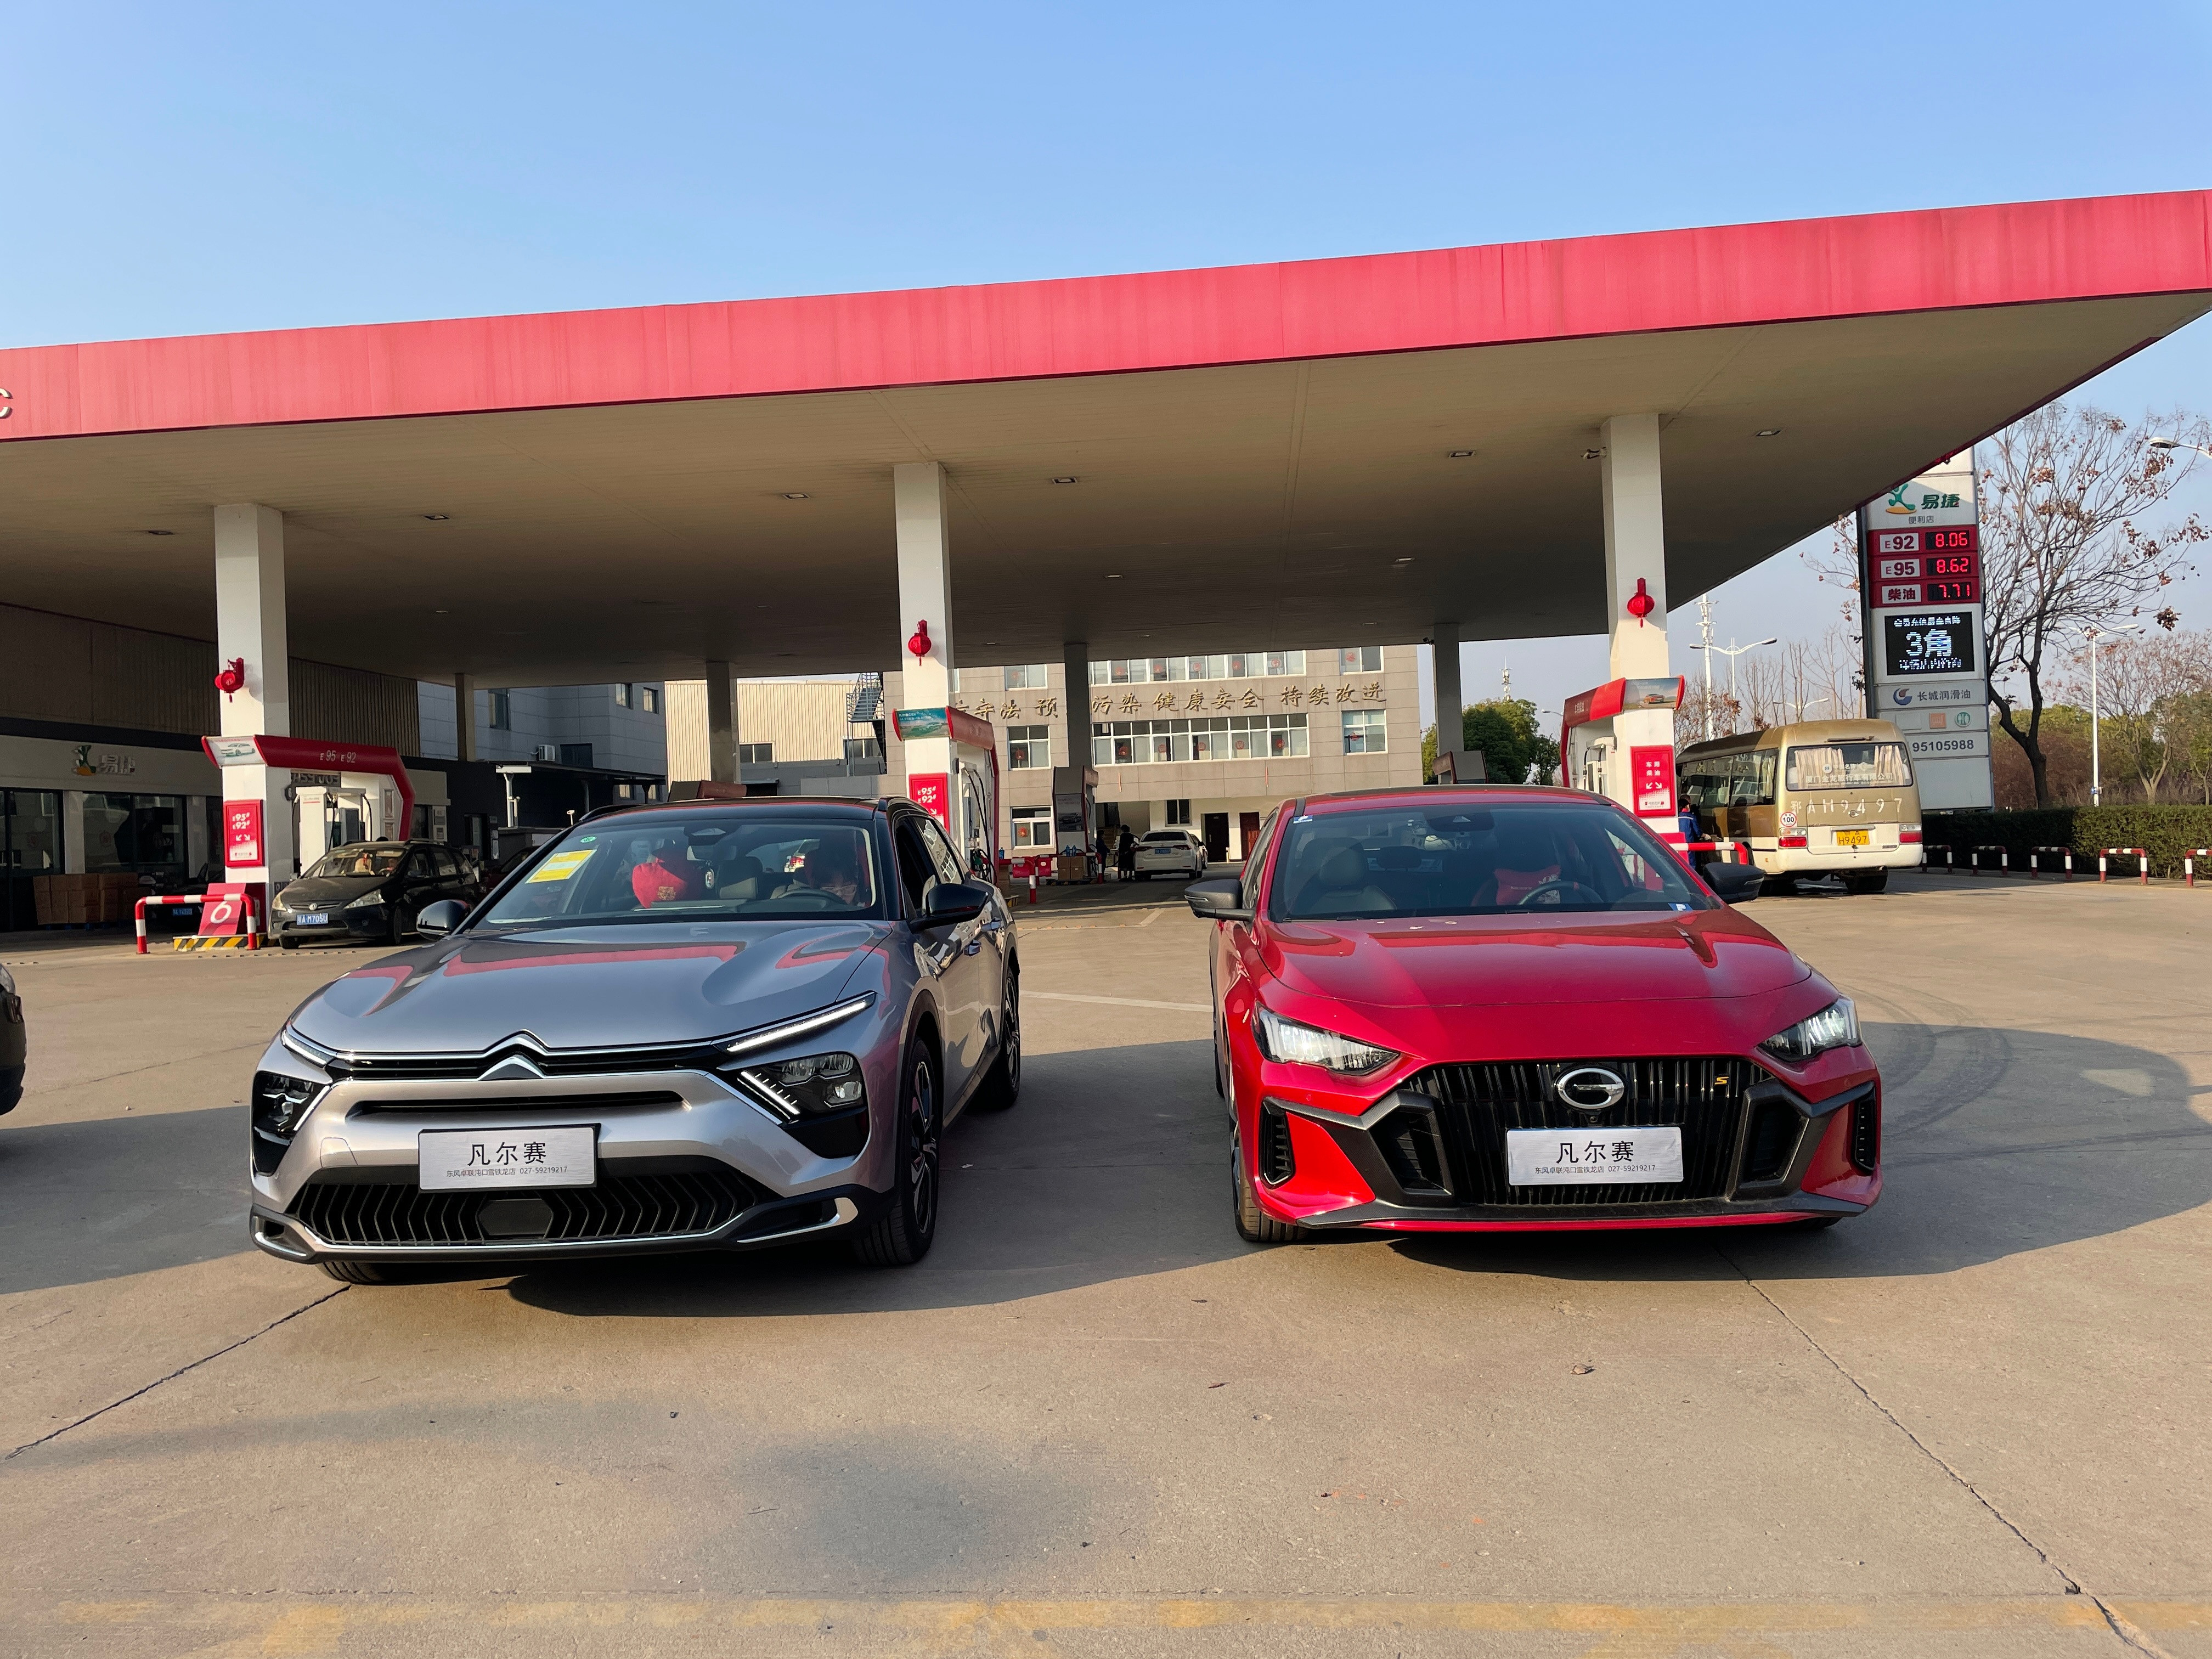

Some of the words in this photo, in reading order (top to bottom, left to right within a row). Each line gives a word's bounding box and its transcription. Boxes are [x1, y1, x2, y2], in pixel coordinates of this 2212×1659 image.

[1921, 494, 1960, 510] 易捷
[1909, 516, 1934, 524] 便利店
[1936, 532, 1968, 548] 8.06
[1937, 557, 1969, 573] 8.62
[1888, 588, 1916, 601] 柴油
[1938, 584, 1970, 597] 7.71
[1906, 629, 1952, 657] 3角
[1279, 681, 1387, 707] 持续改进
[1917, 689, 1971, 702] 长城润滑油
[1912, 740, 1974, 752] 95105988
[1838, 837, 1867, 845] H9497
[210, 901, 232, 924] 6
[467, 1141, 547, 1167] 凡尔赛
[1556, 1140, 1634, 1164] 凡尔赛
[520, 1166, 568, 1175] 027-59219217
[1608, 1164, 1656, 1173] 027-59219217
